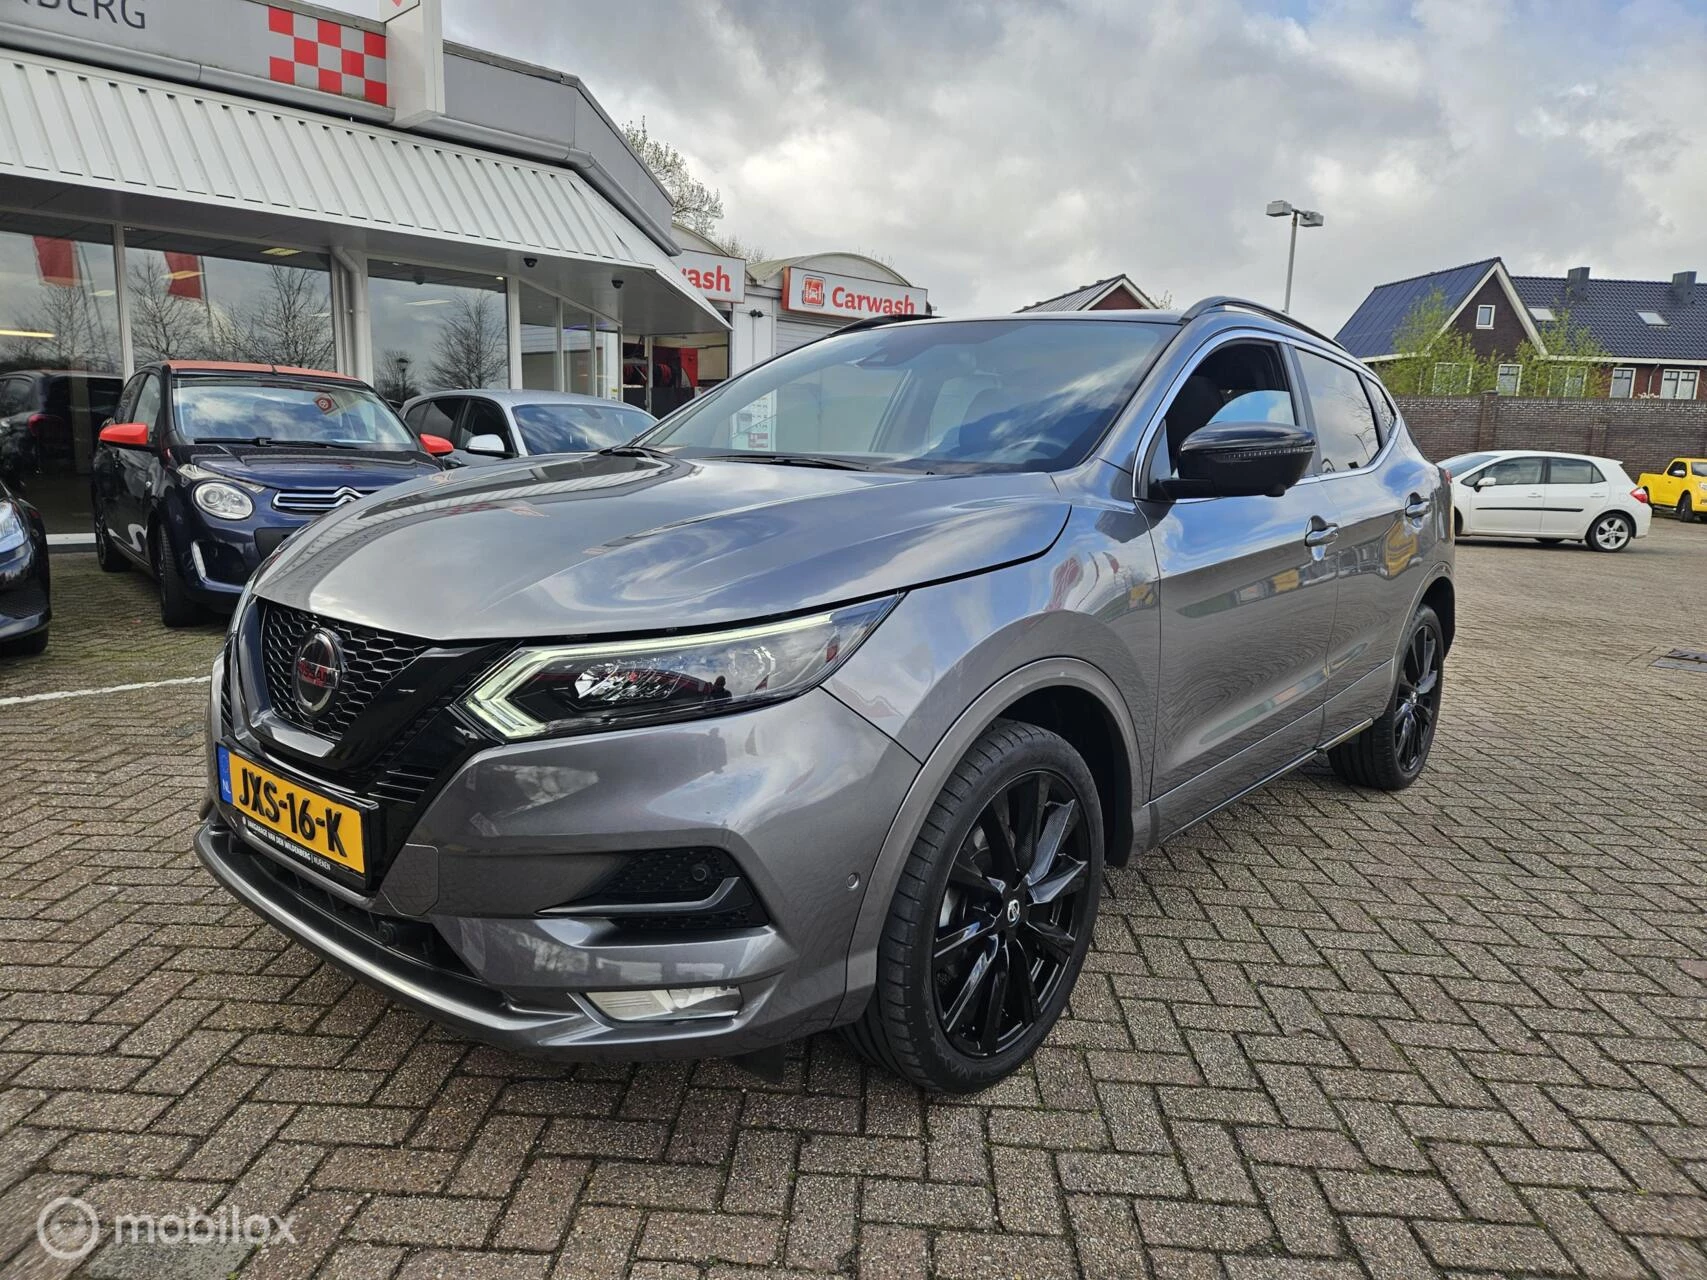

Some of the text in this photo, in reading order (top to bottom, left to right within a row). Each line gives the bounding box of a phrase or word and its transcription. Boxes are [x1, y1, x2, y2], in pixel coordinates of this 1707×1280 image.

[681, 265, 731, 293] ash
[831, 286, 915, 315] Carwash
[239, 767, 348, 858] JXS-16-K
